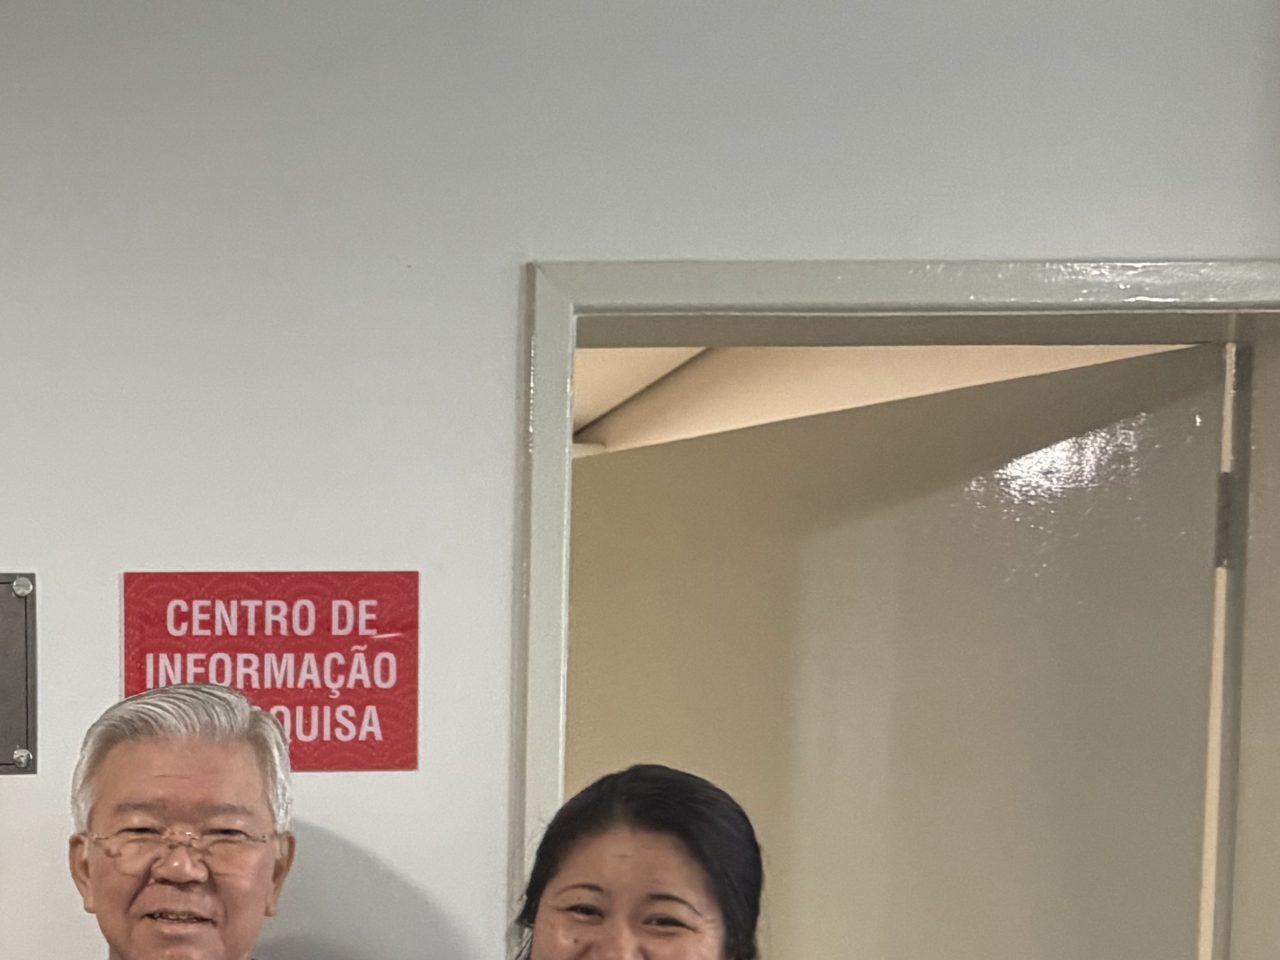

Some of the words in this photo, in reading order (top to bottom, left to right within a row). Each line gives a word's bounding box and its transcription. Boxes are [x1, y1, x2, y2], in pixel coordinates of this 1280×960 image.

[166, 599, 316, 637] CENTRO
[331, 599, 378, 636] DE
[145, 645, 397, 698] INFORMAÇÃO
[251, 705, 383, 743] QUISA
